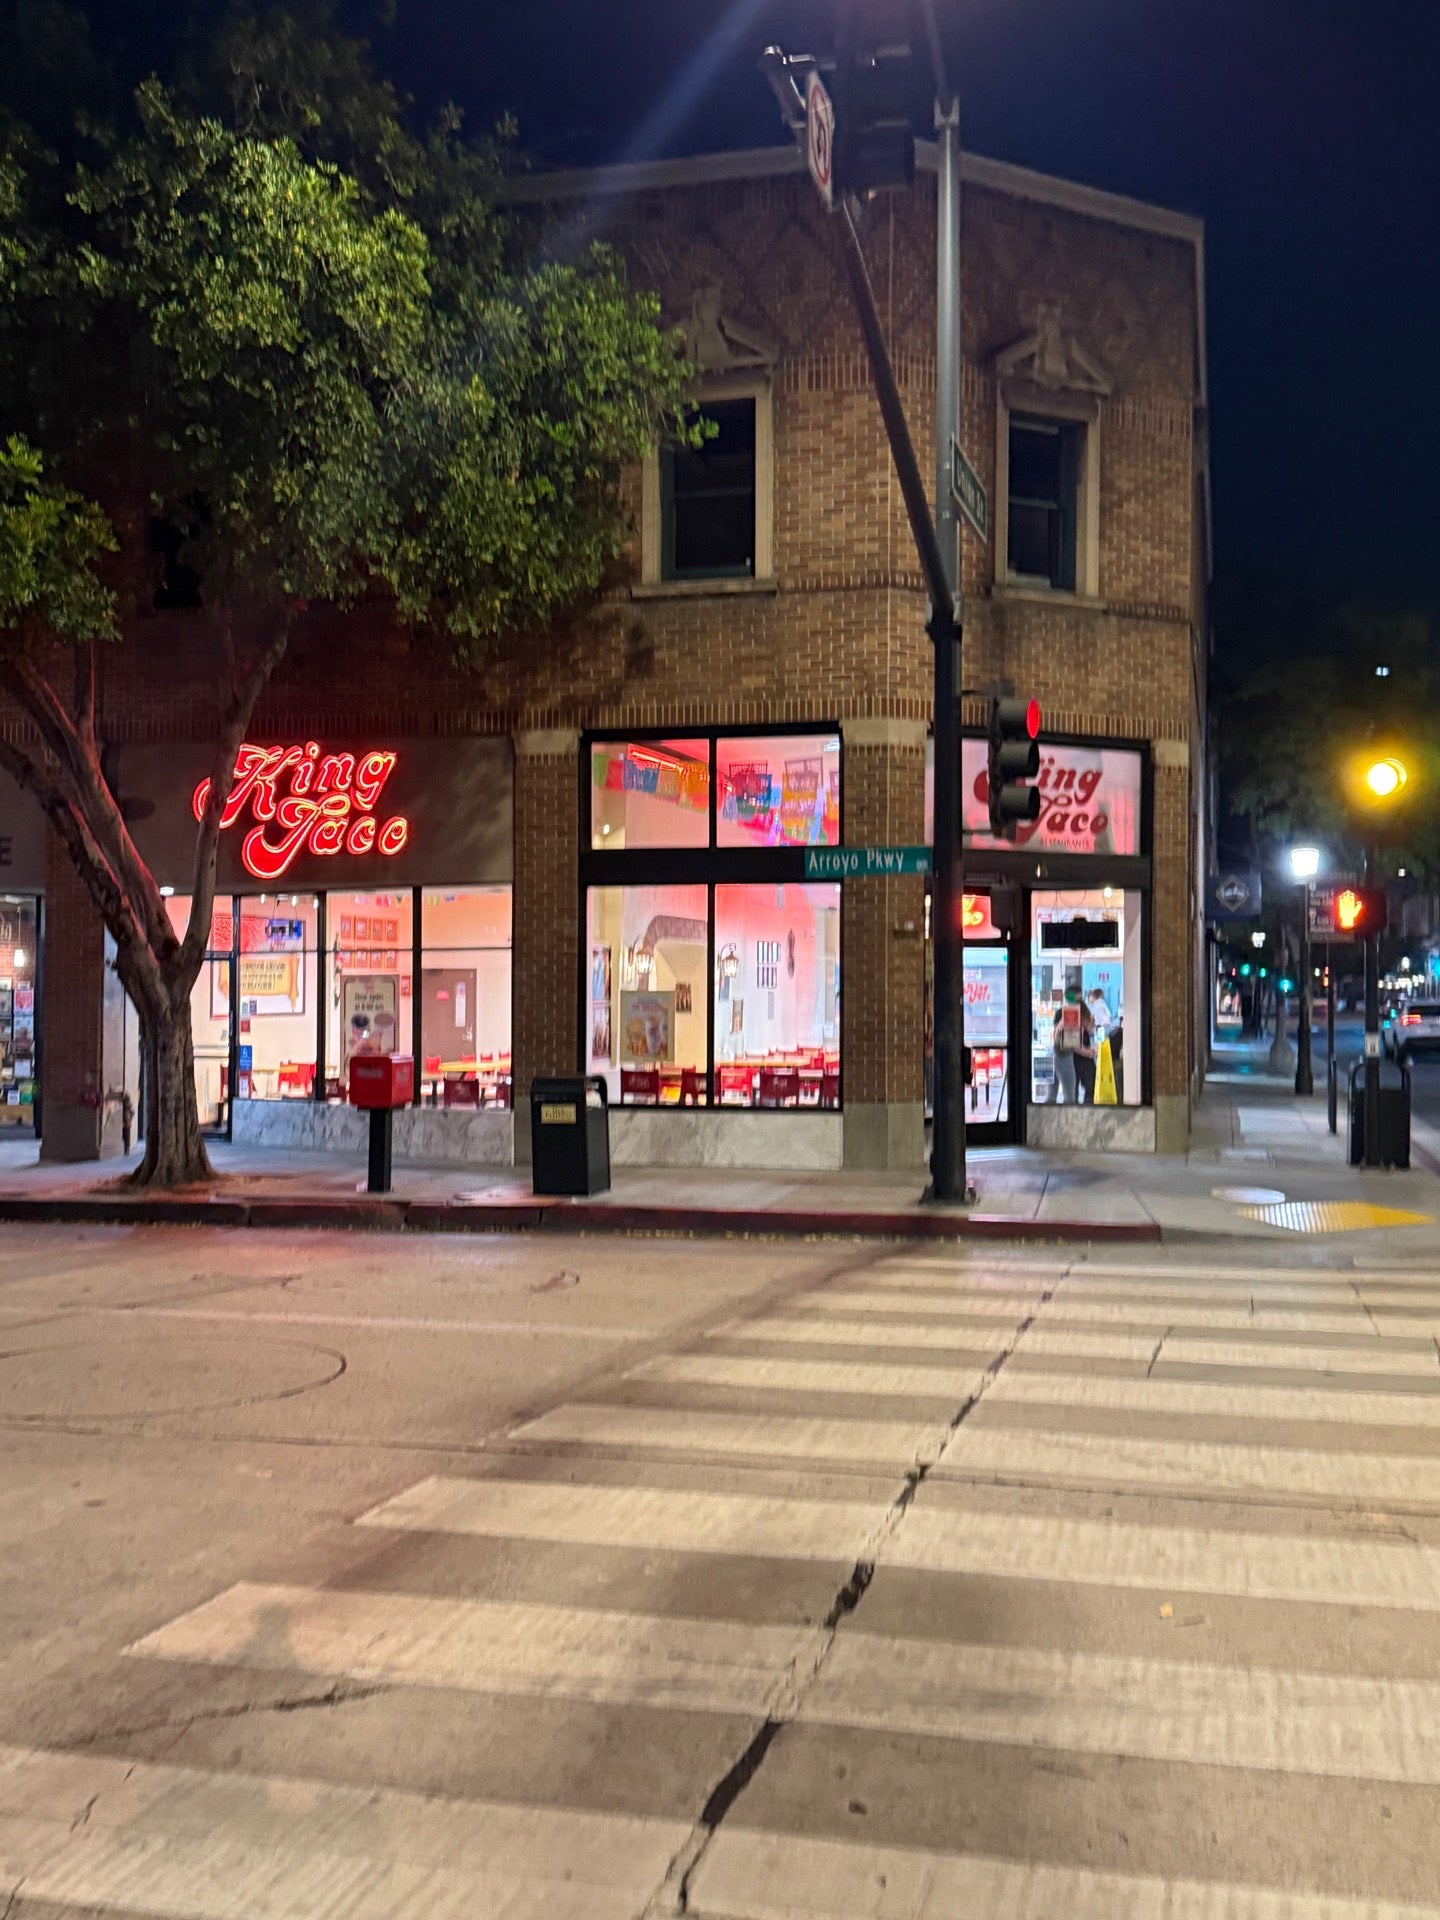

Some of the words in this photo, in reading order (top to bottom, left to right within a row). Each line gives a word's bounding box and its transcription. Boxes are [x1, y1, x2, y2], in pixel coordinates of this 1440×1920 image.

[192, 741, 396, 829] King
[242, 791, 408, 879] Taco
[808, 849, 859, 875] Arroyo
[866, 847, 904, 873] Pkwy
